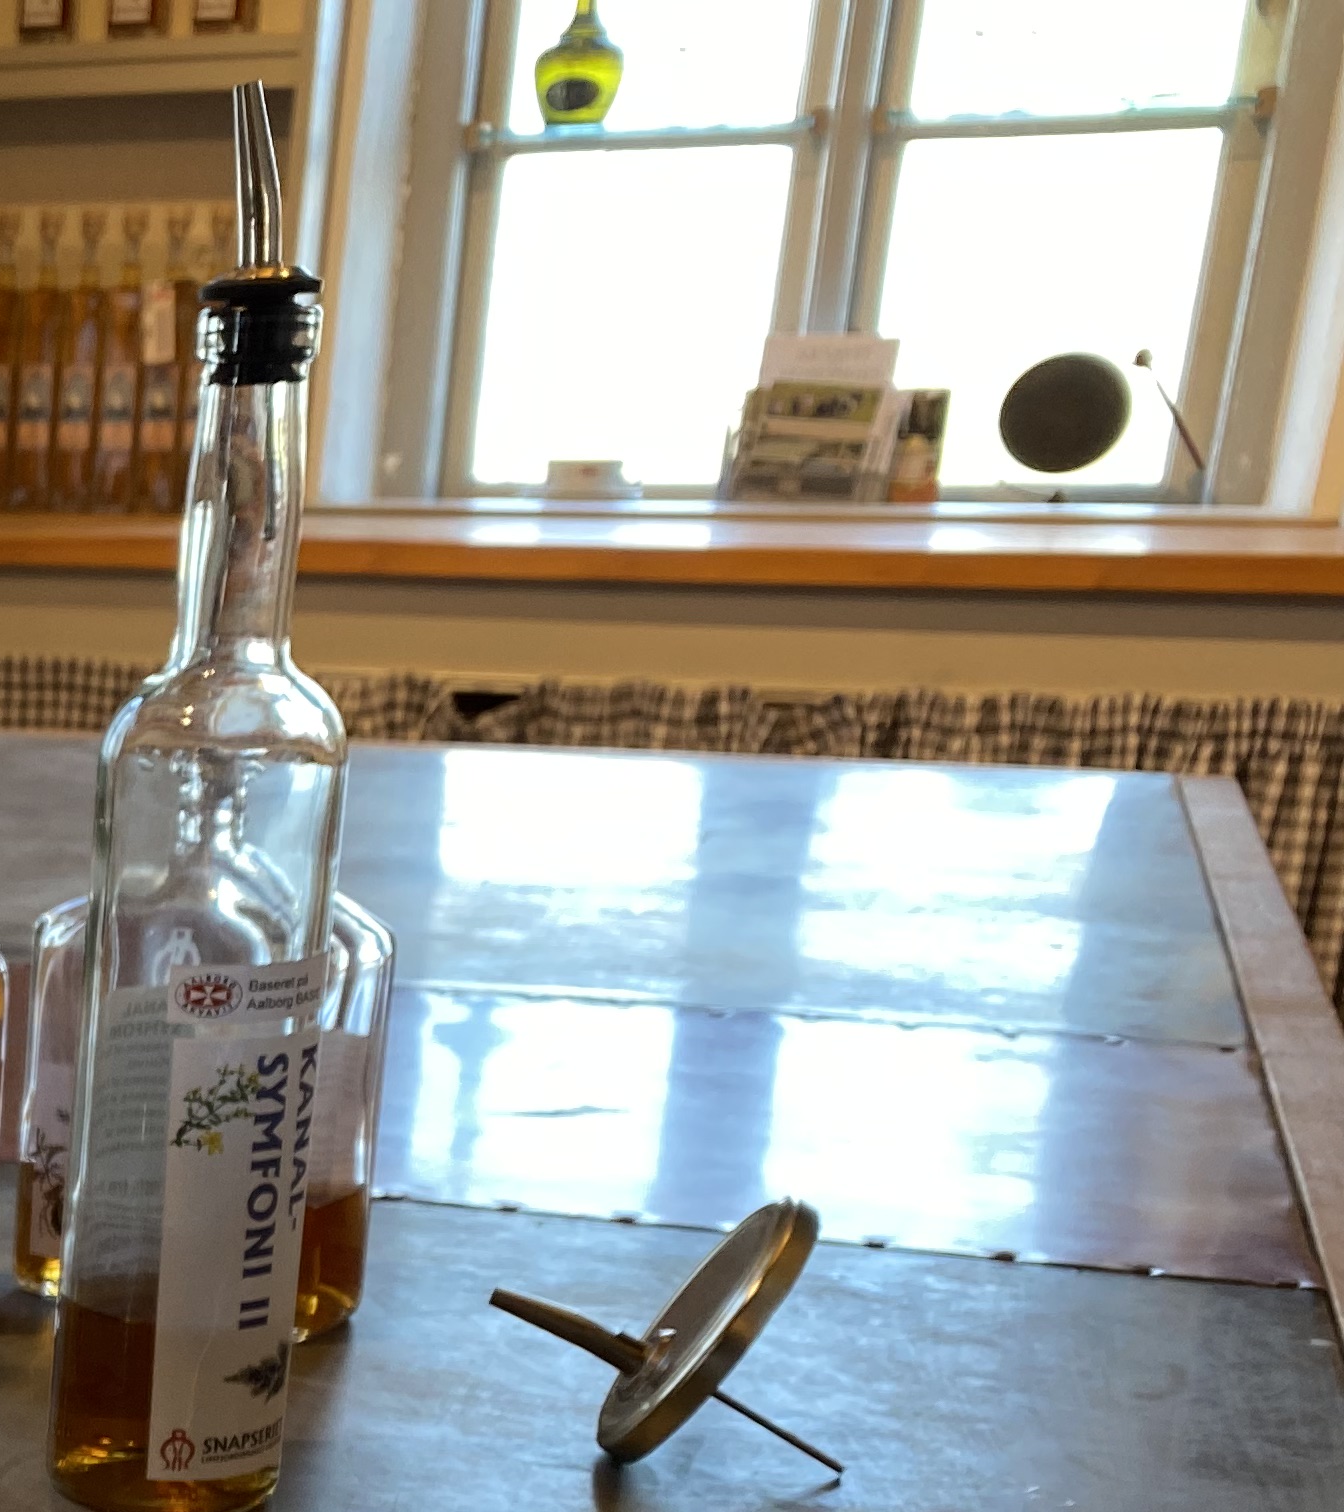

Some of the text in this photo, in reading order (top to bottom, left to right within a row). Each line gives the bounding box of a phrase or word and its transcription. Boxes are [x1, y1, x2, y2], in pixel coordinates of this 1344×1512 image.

[248, 976, 295, 993] Baseret
[246, 995, 294, 1011] Aalborg
[238, 1053, 290, 1331] SYMFONI II
